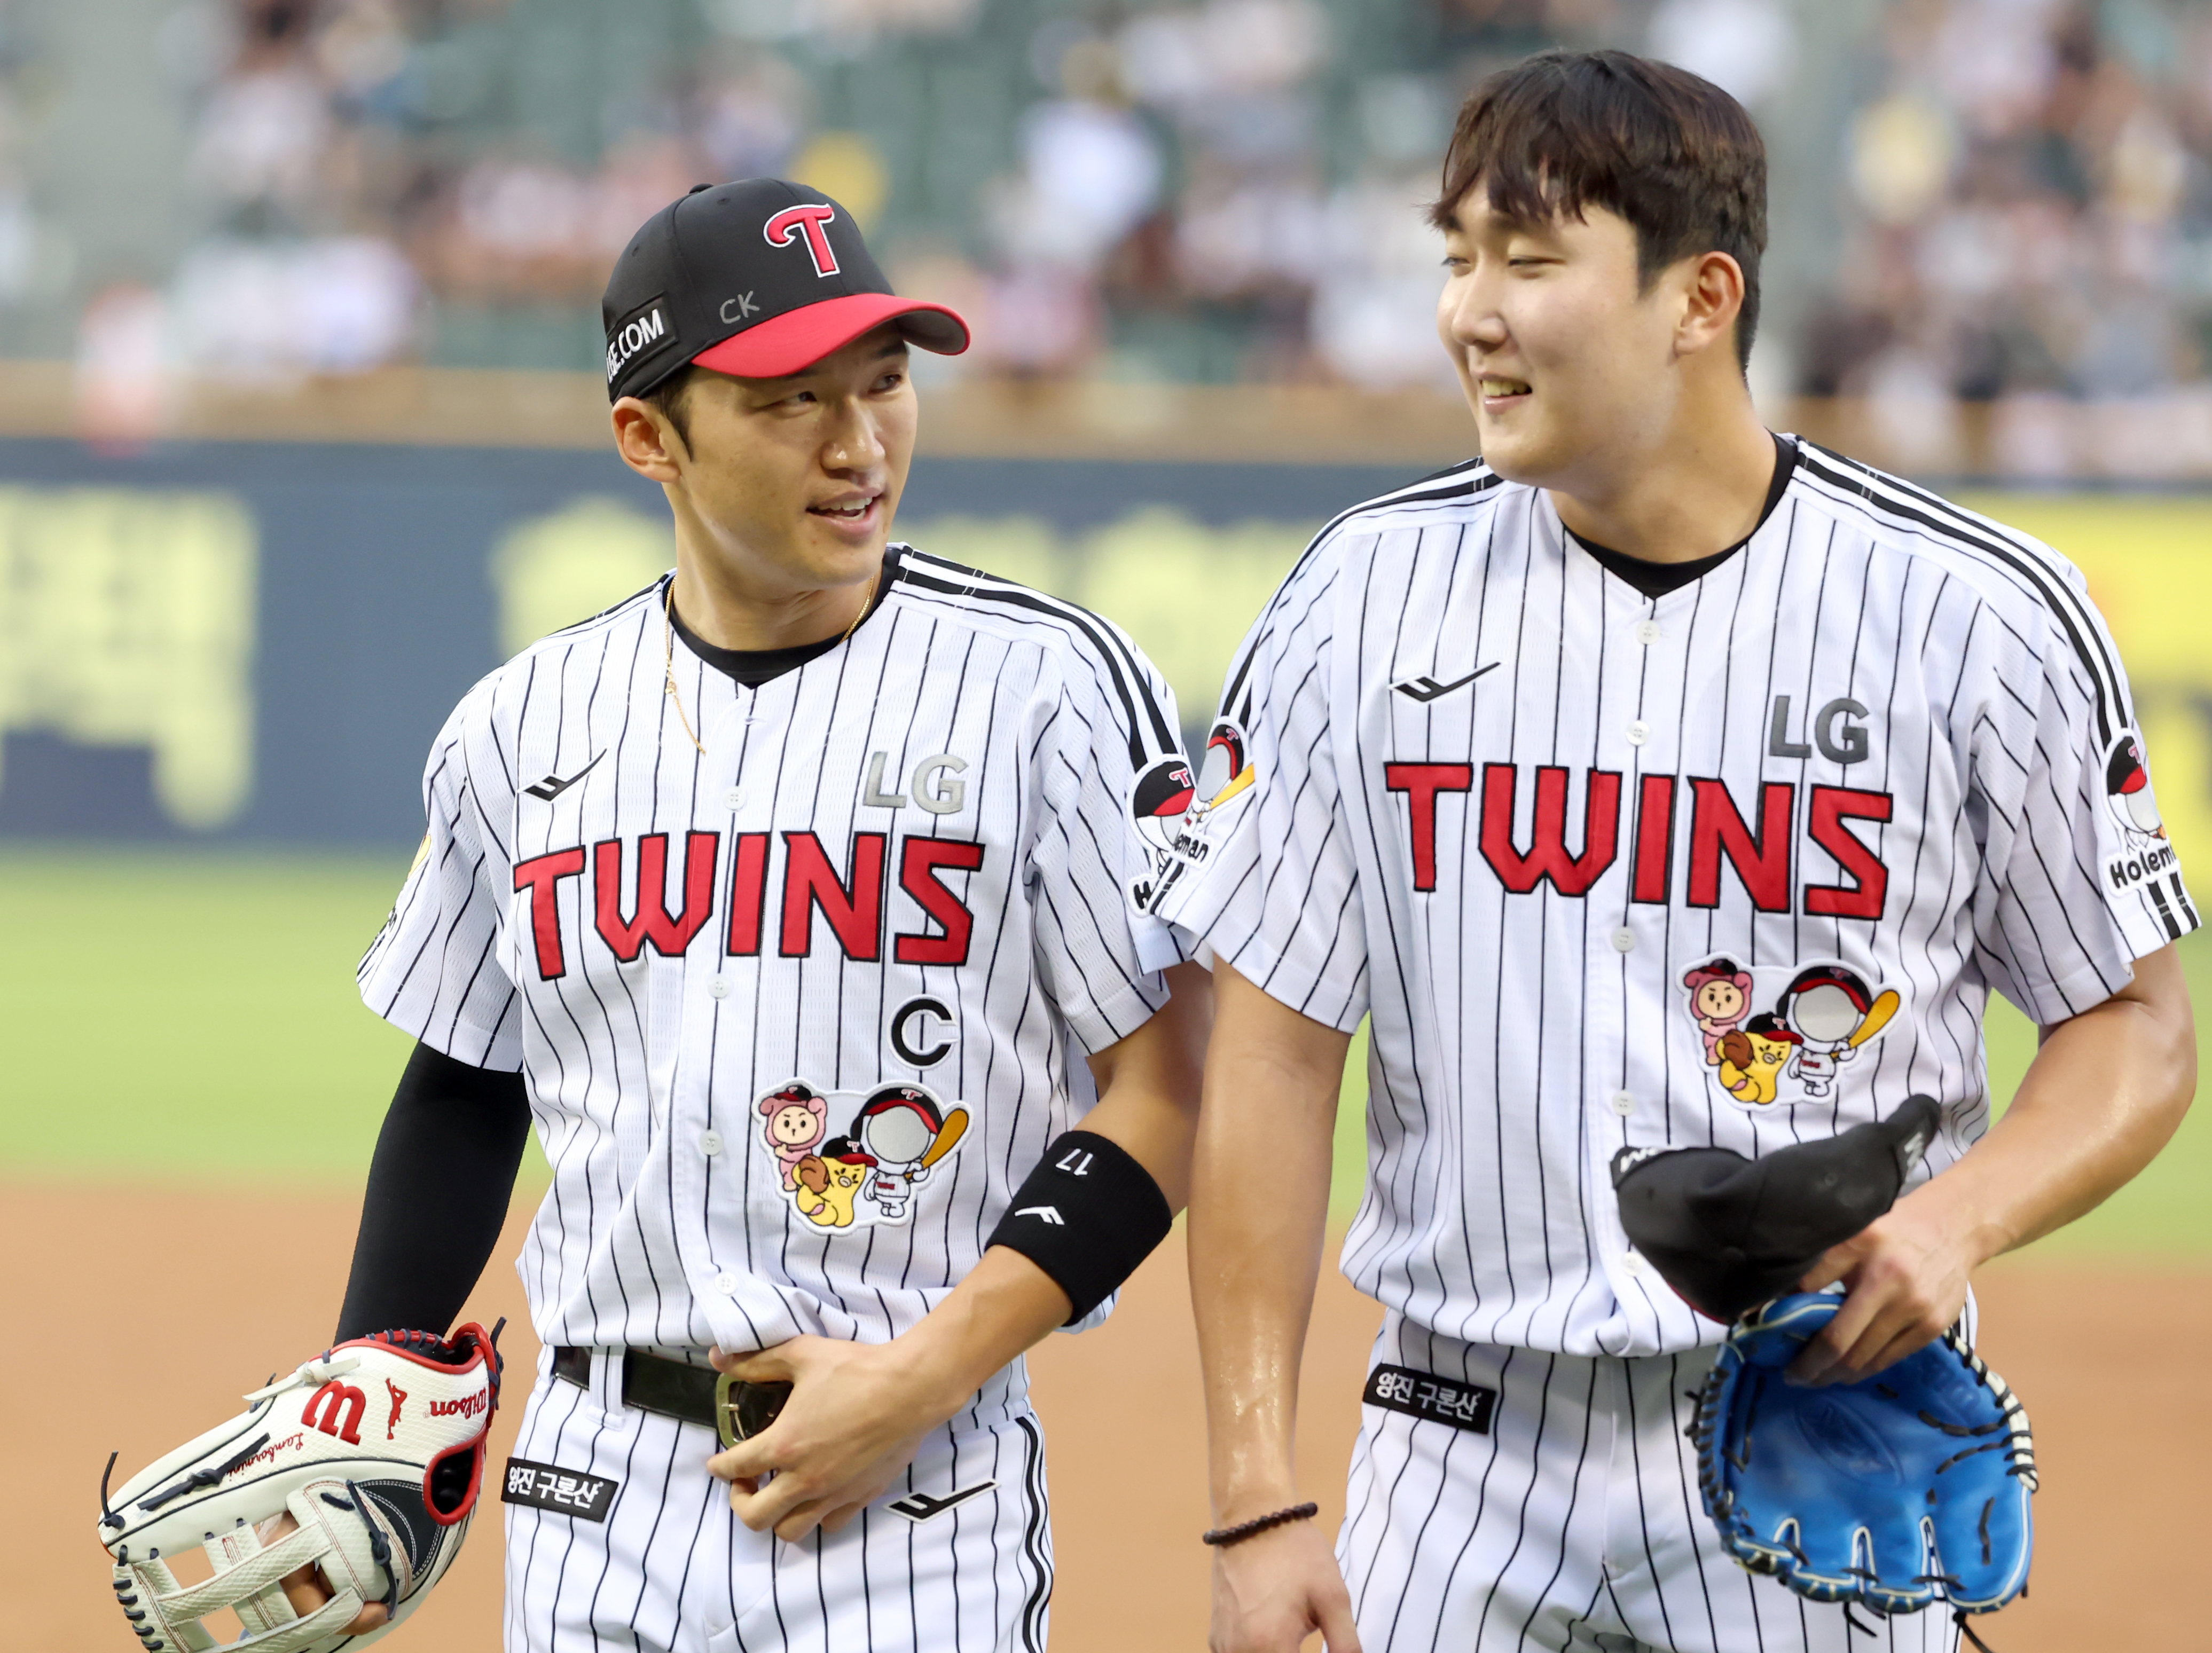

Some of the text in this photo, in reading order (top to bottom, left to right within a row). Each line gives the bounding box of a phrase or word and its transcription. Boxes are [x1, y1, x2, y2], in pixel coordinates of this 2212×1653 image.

[763, 203, 841, 278] T
[719, 290, 760, 324] CK
[1768, 695, 1870, 764] LG
[862, 751, 969, 814] LG
[1384, 761, 1893, 920] TWINS
[513, 830, 986, 981] TWINS
[889, 997, 956, 1068] C
[1055, 1148, 1093, 1176] 17
[430, 1387, 487, 1420] Wilson
[1376, 1372, 1478, 1422] 영진 구론산
[508, 1466, 600, 1509] 영진 구론산
